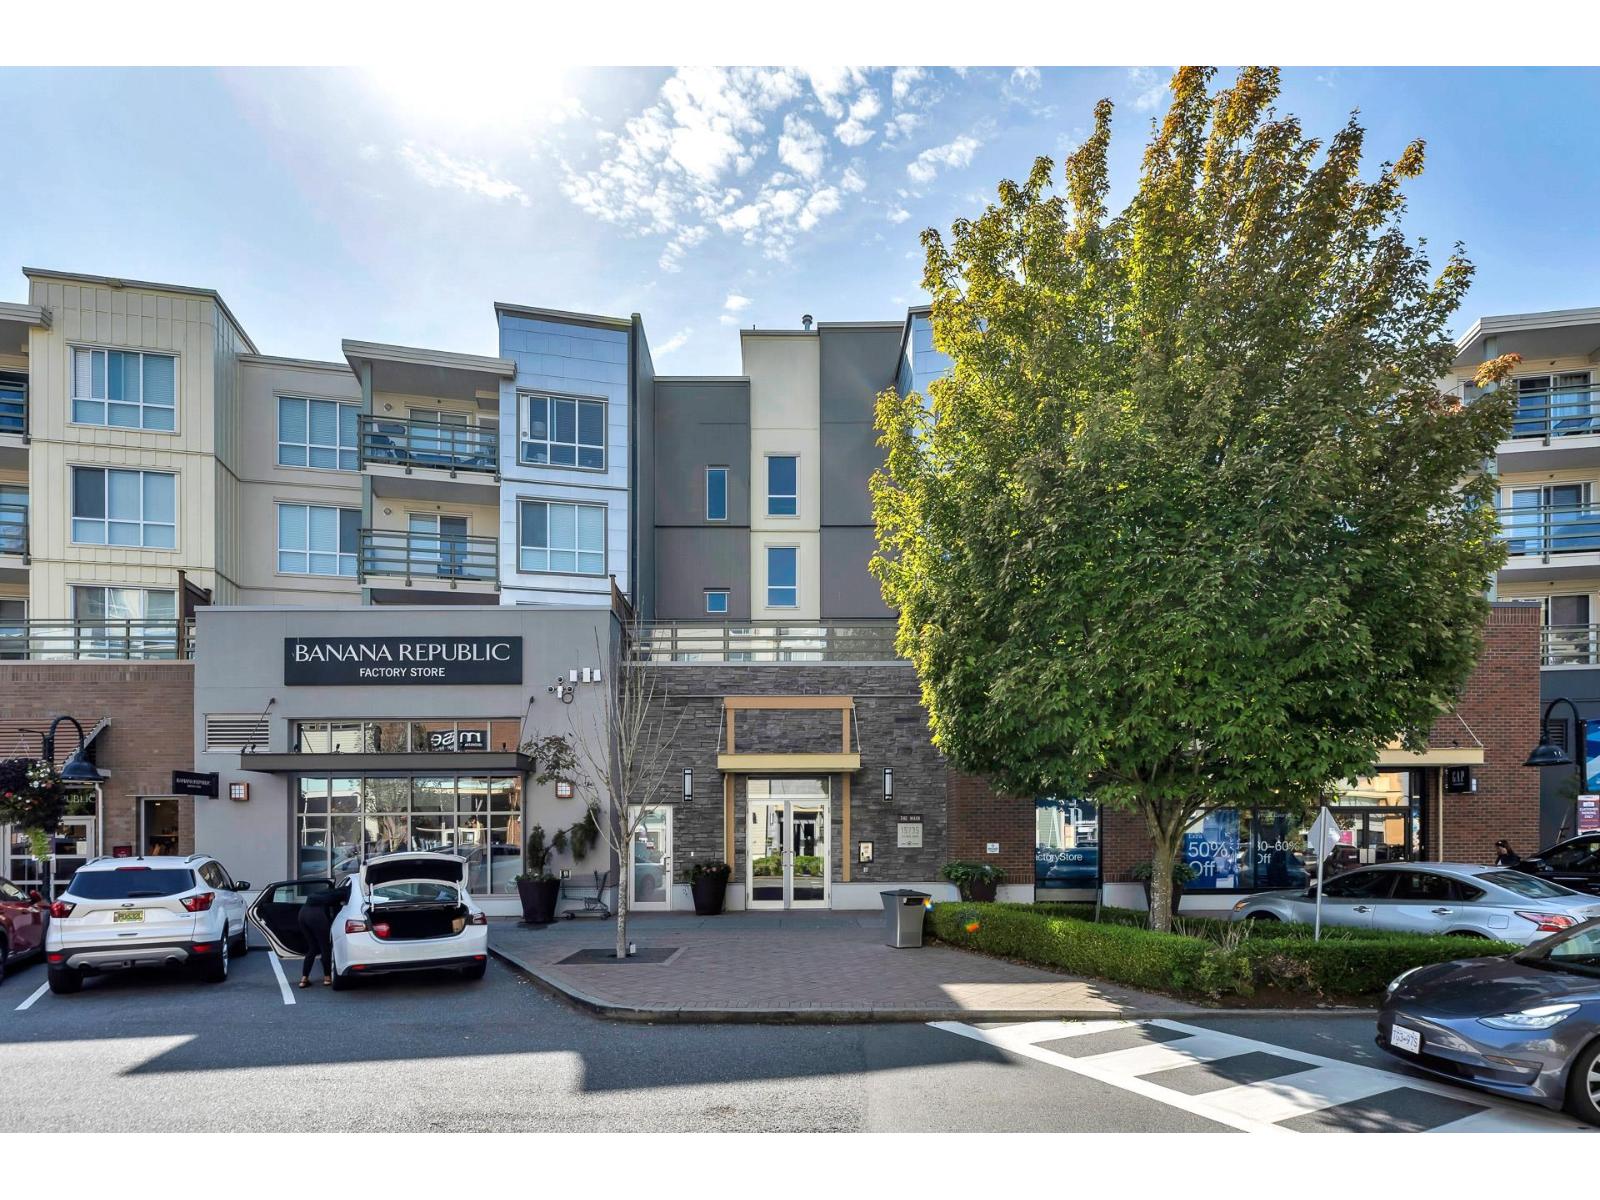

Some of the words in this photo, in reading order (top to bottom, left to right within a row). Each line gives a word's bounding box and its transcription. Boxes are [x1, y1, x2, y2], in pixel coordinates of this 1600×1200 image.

[295, 644, 393, 662] BANANA
[400, 643, 510, 662] REPUBLIC
[359, 667, 407, 677] FACTORY
[410, 667, 446, 677] STORE
[1188, 841, 1229, 858] 50%
[1189, 860, 1216, 877] Off
